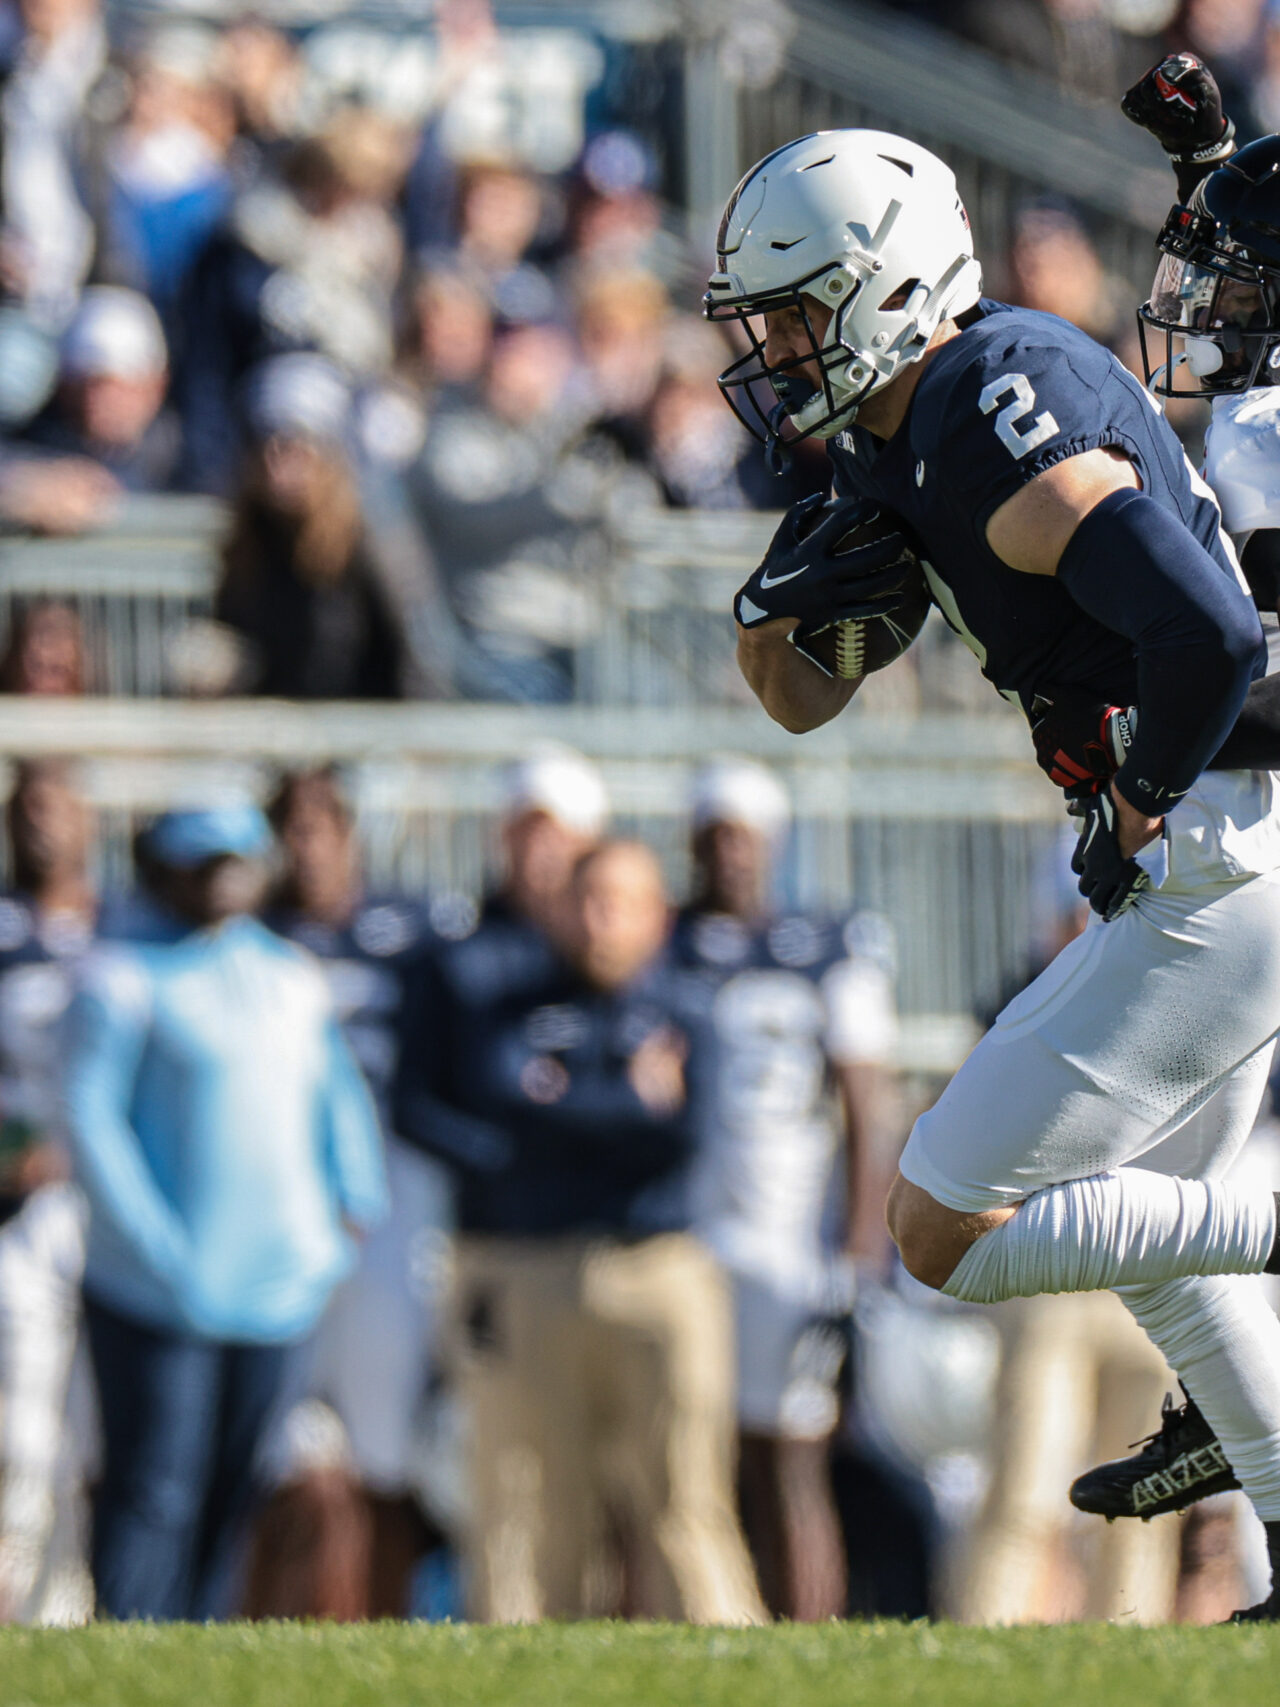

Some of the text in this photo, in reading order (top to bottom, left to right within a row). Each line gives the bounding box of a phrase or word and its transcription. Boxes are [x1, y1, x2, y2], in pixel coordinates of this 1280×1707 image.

[1193, 142, 1223, 160] CHOP
[978, 373, 1060, 460] 2
[1118, 715, 1132, 747] CHOP
